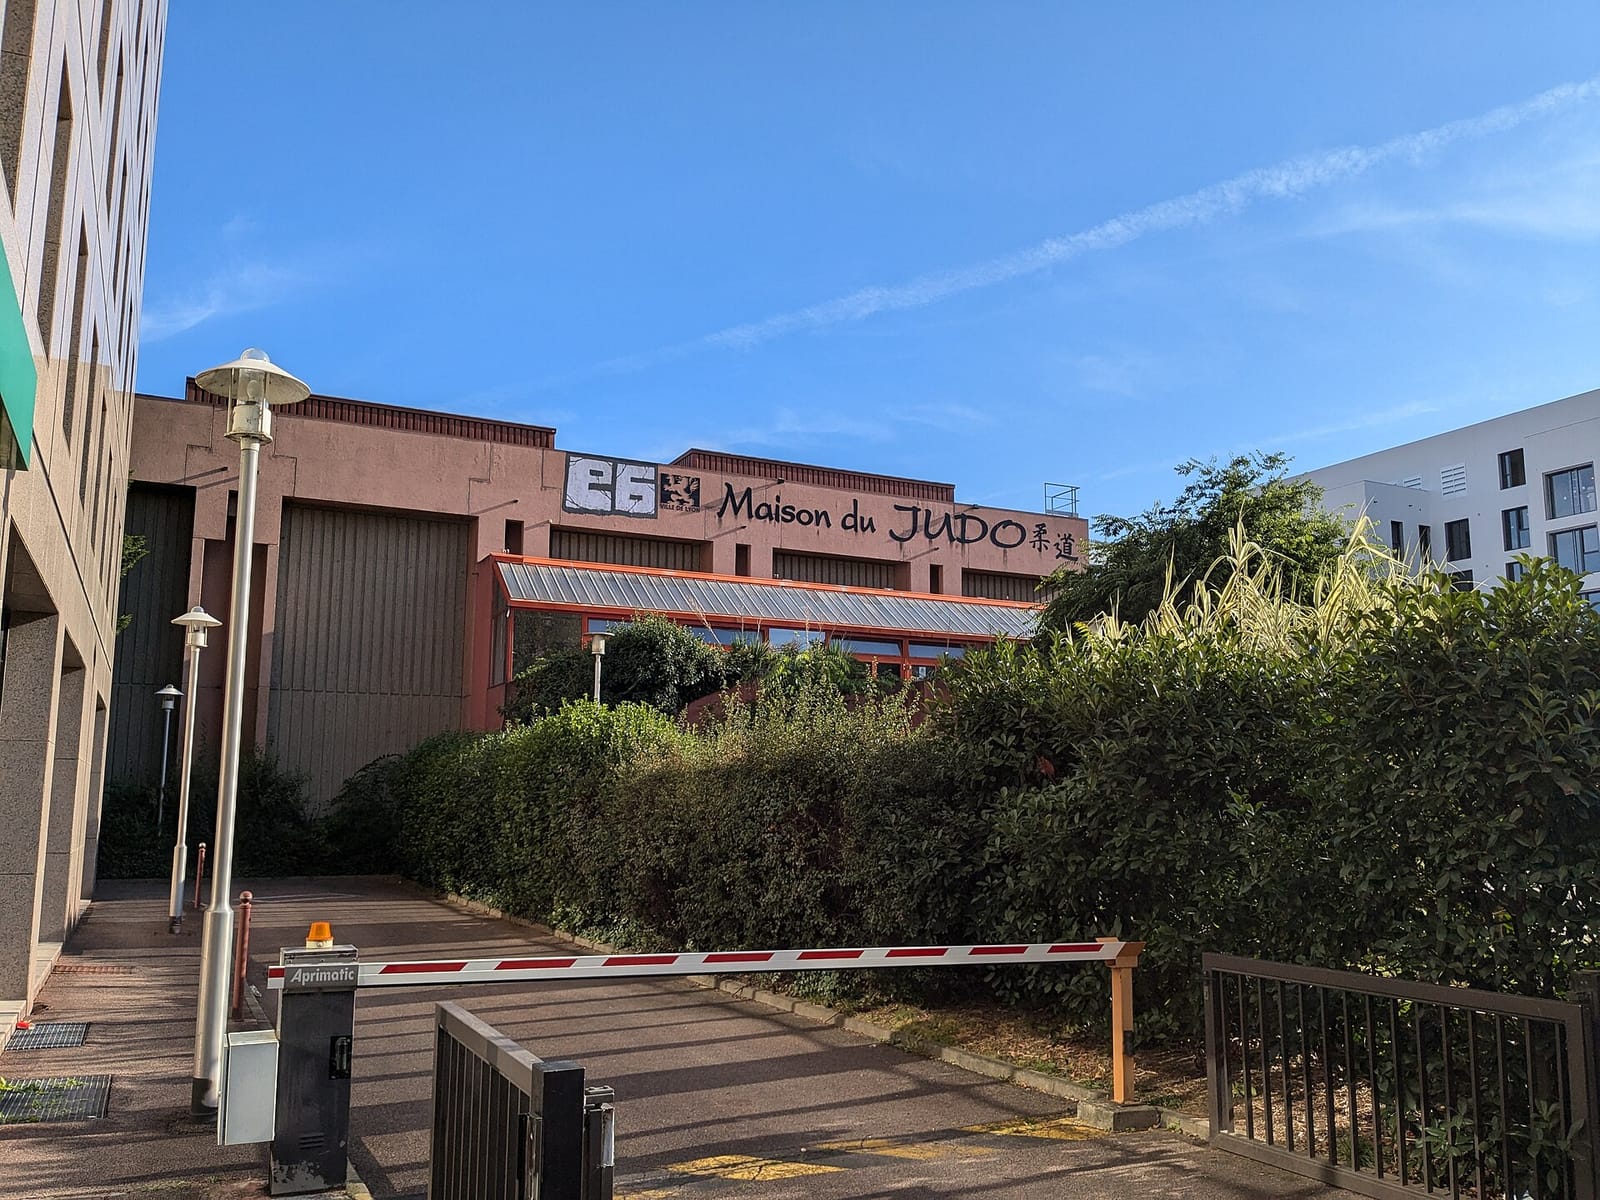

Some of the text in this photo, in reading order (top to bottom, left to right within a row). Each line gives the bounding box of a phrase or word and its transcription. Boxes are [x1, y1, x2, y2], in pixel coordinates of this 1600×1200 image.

[717, 482, 1027, 549] Maison du JUDO
[1029, 522, 1079, 561] 柔道
[291, 967, 355, 986] Aprimatic
